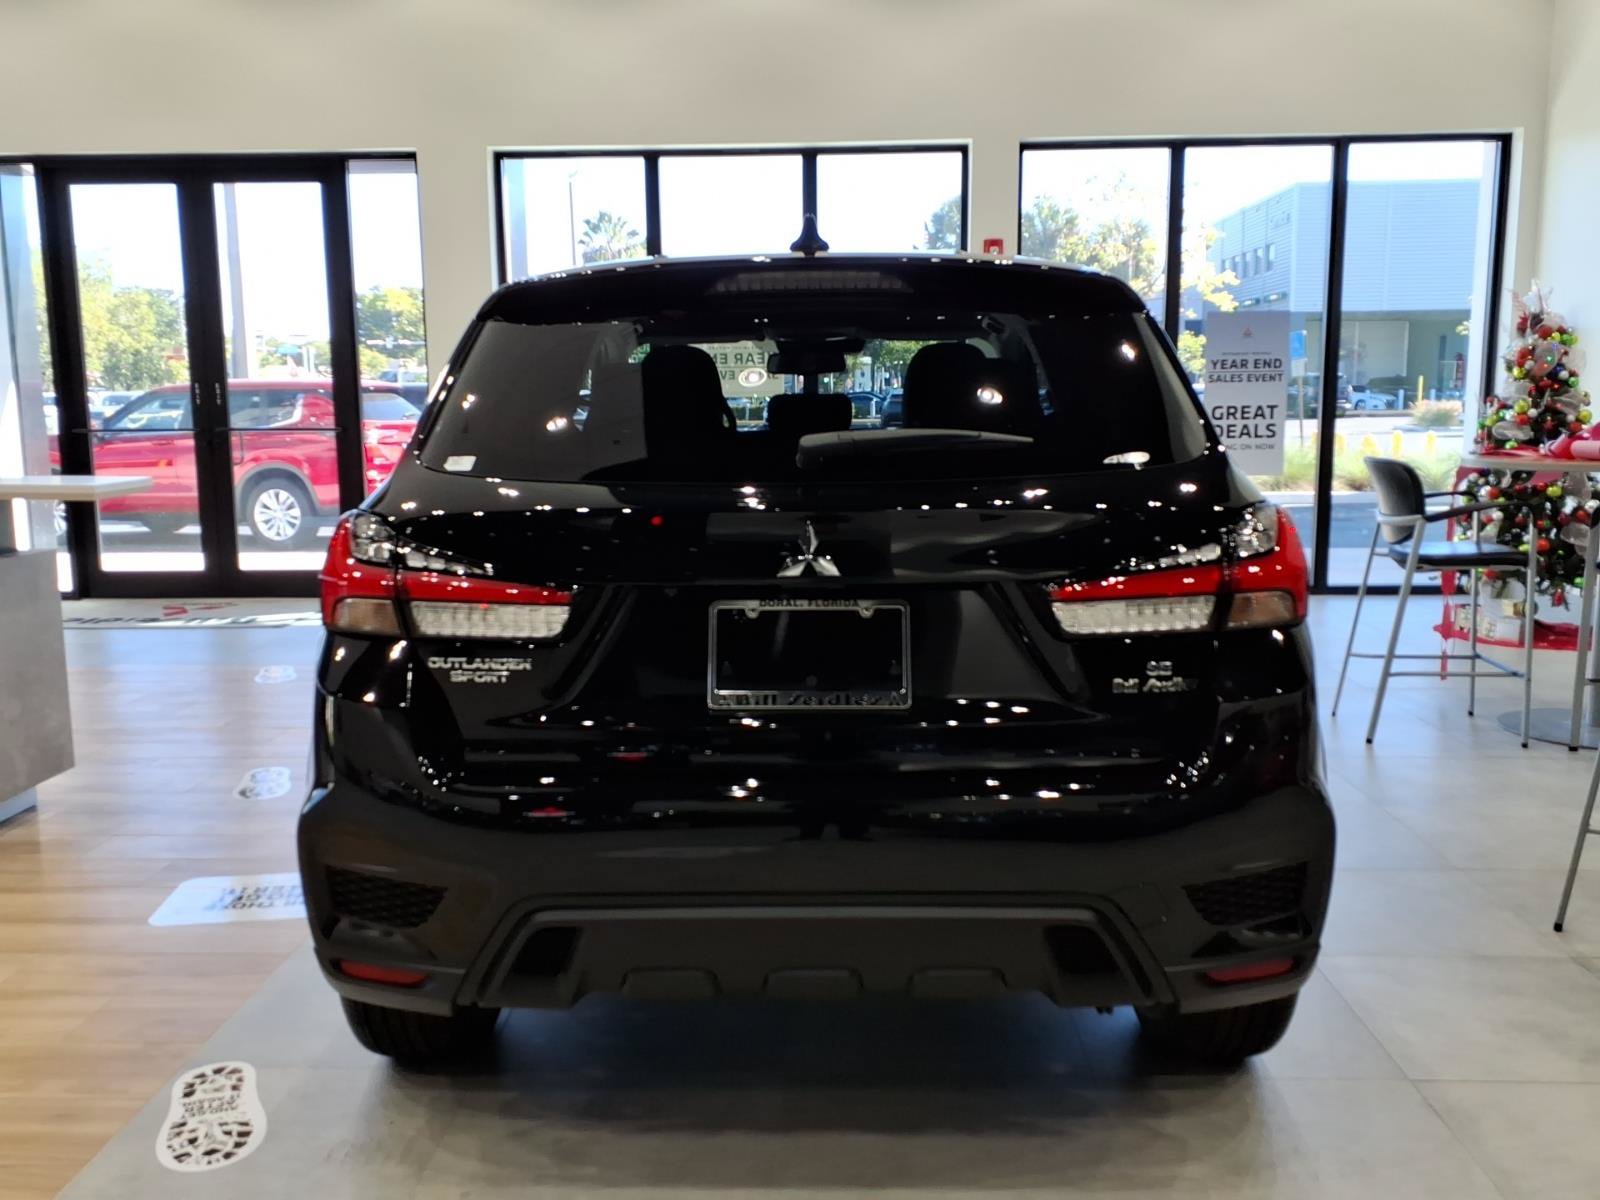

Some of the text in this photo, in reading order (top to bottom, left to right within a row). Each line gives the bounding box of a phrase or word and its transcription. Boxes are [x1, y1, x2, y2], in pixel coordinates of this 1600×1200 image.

[1211, 358, 1283, 370] YEAR END
[1208, 373, 1284, 383] SALES EVENT
[1211, 404, 1279, 420] GREAT
[808, 598, 860, 607] FLORIDA
[427, 657, 533, 670] OUTLANDER
[449, 670, 510, 683] SPORT
